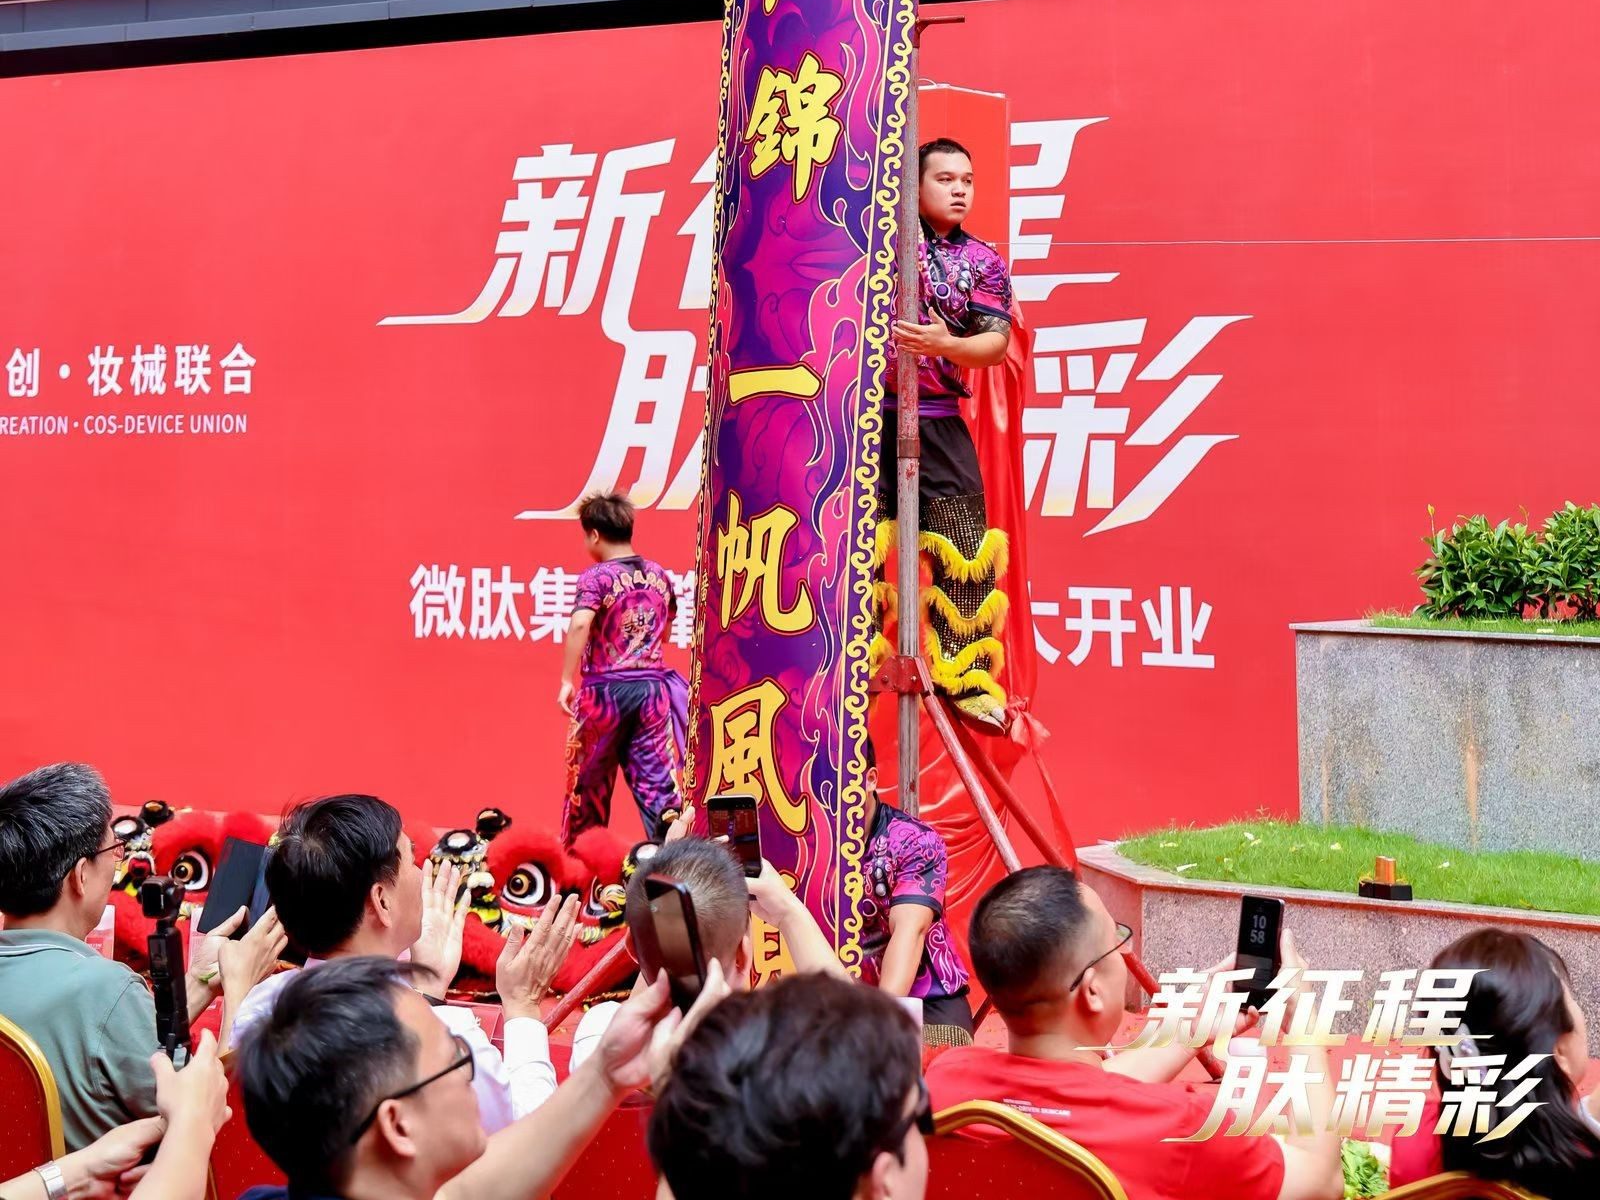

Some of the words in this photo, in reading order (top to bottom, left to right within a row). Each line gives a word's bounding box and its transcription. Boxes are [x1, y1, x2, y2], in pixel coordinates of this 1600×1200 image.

[84, 415, 184, 434] COS-DEVICE
[190, 414, 247, 433] UNION
[1252, 914, 1267, 929] 10
[1250, 929, 1265, 944] 58
